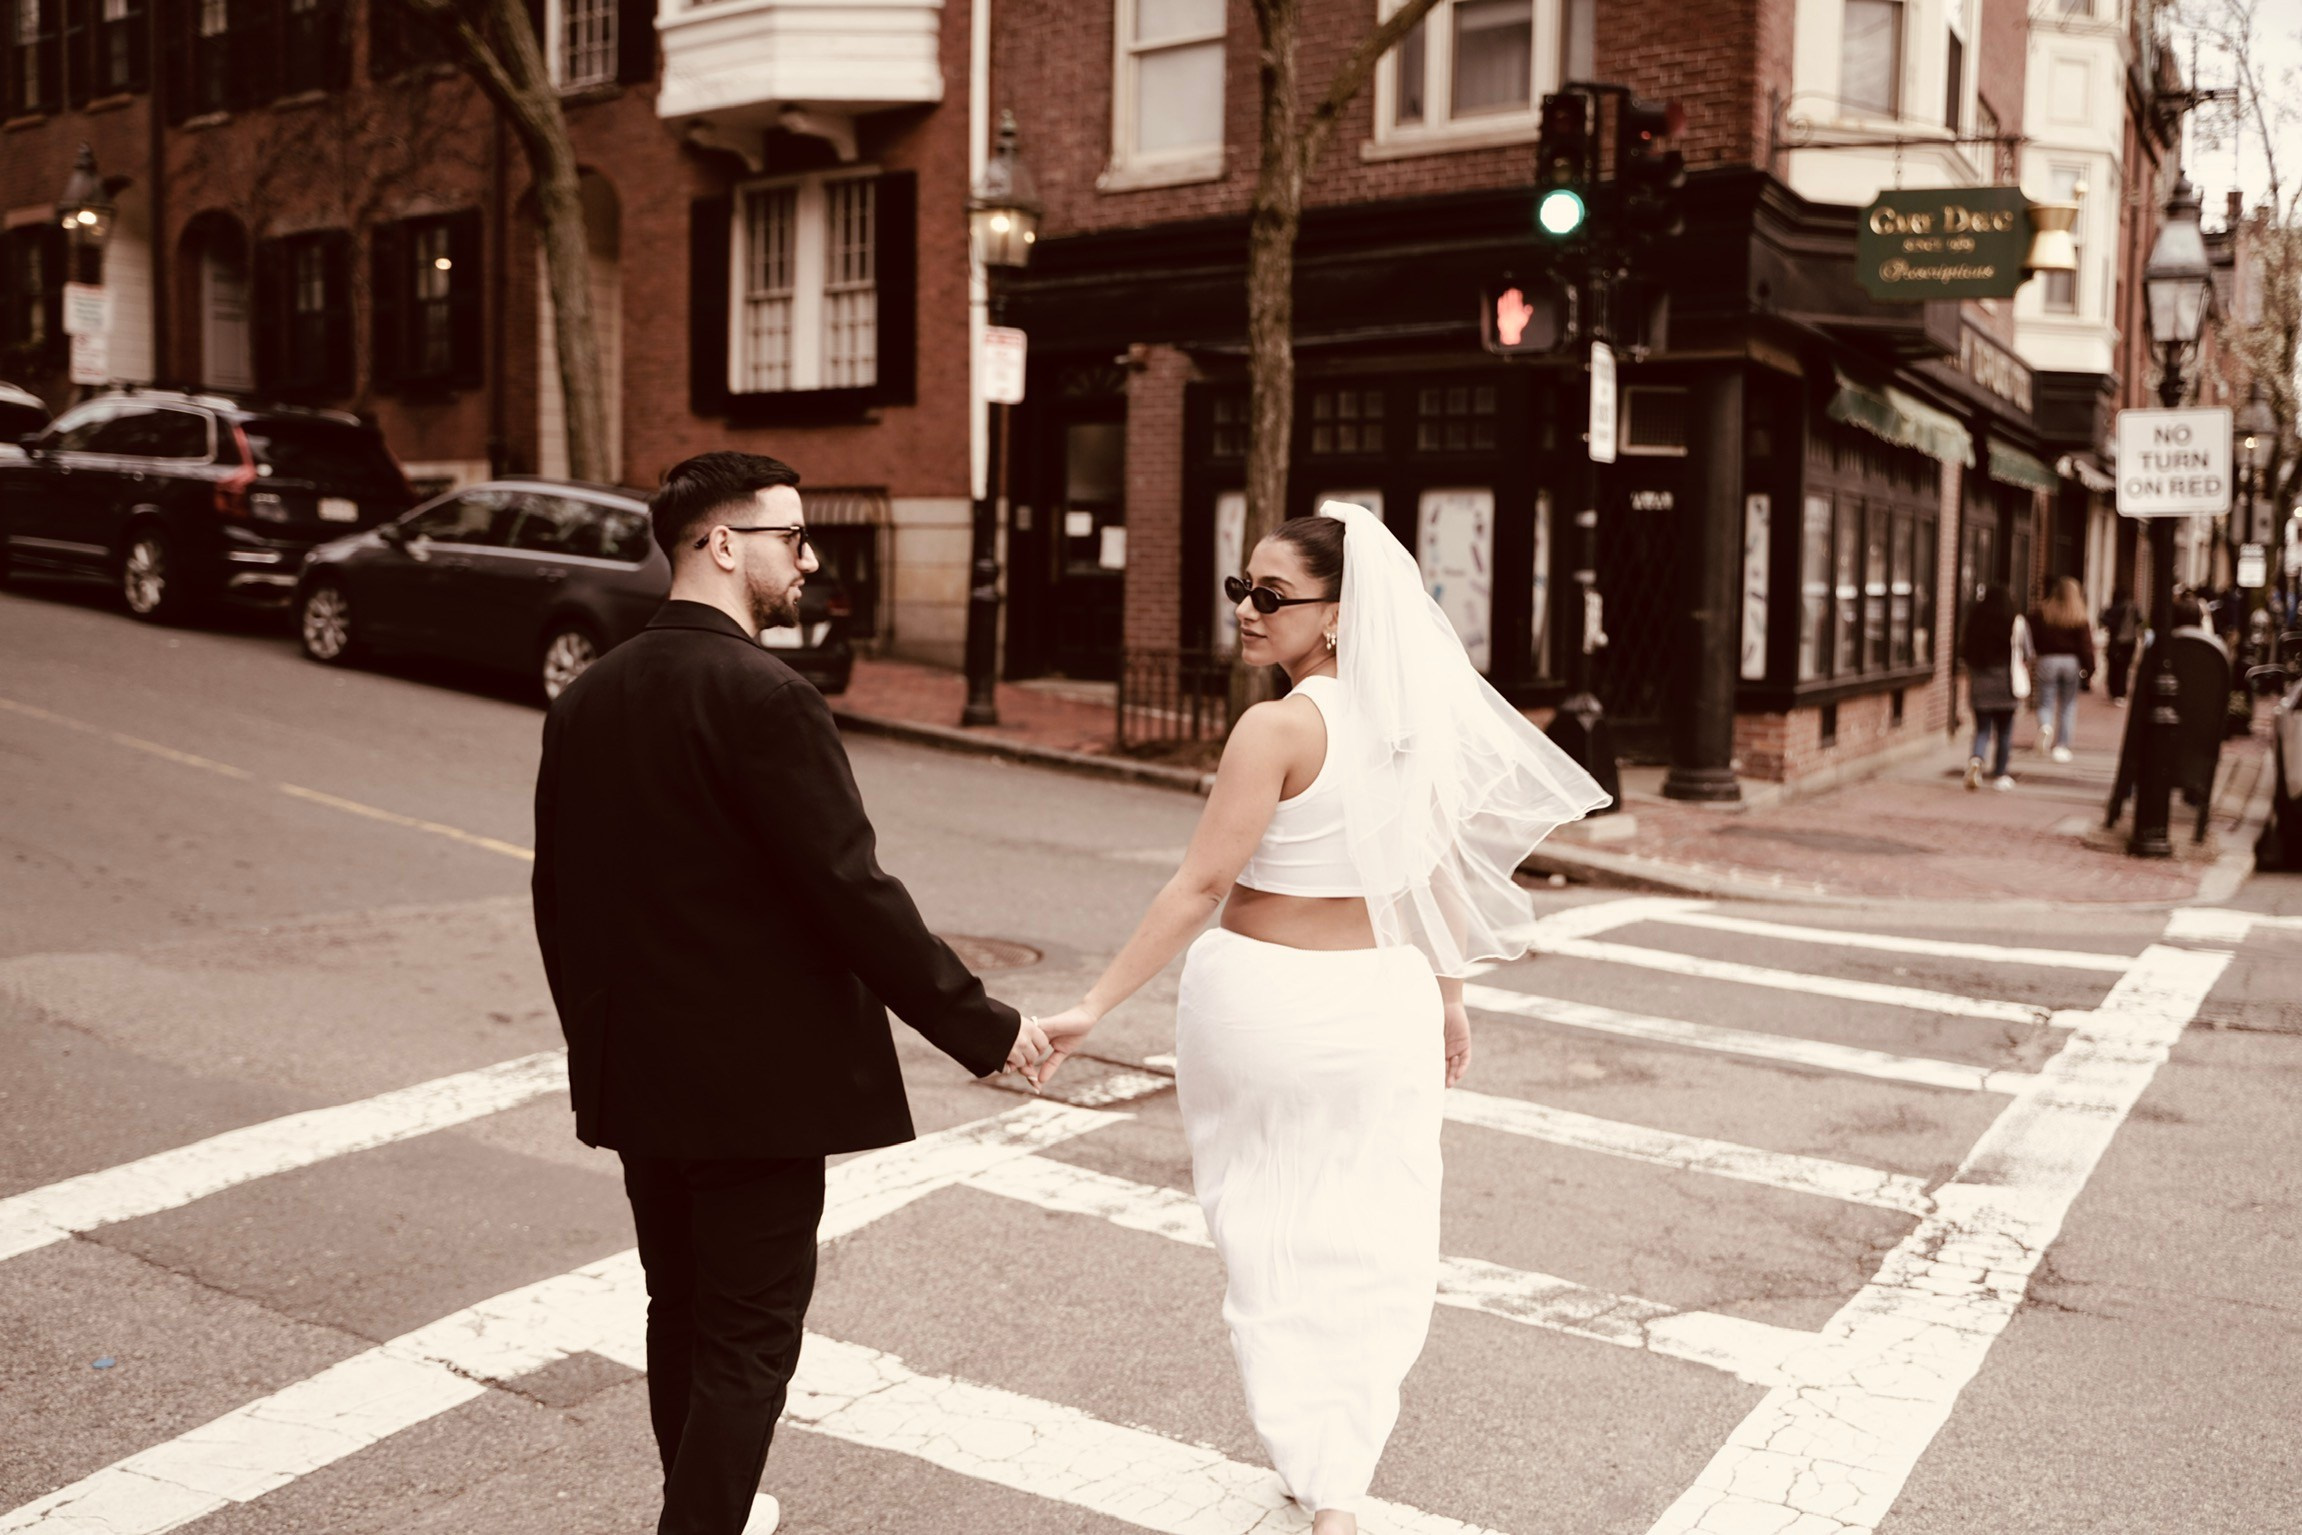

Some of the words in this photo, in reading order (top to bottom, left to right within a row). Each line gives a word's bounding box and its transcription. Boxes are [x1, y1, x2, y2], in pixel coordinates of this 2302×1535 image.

[2154, 424, 2193, 446] NO
[2138, 450, 2210, 472] TURN
[2125, 477, 2162, 499] ON
[2168, 475, 2223, 497] RED
